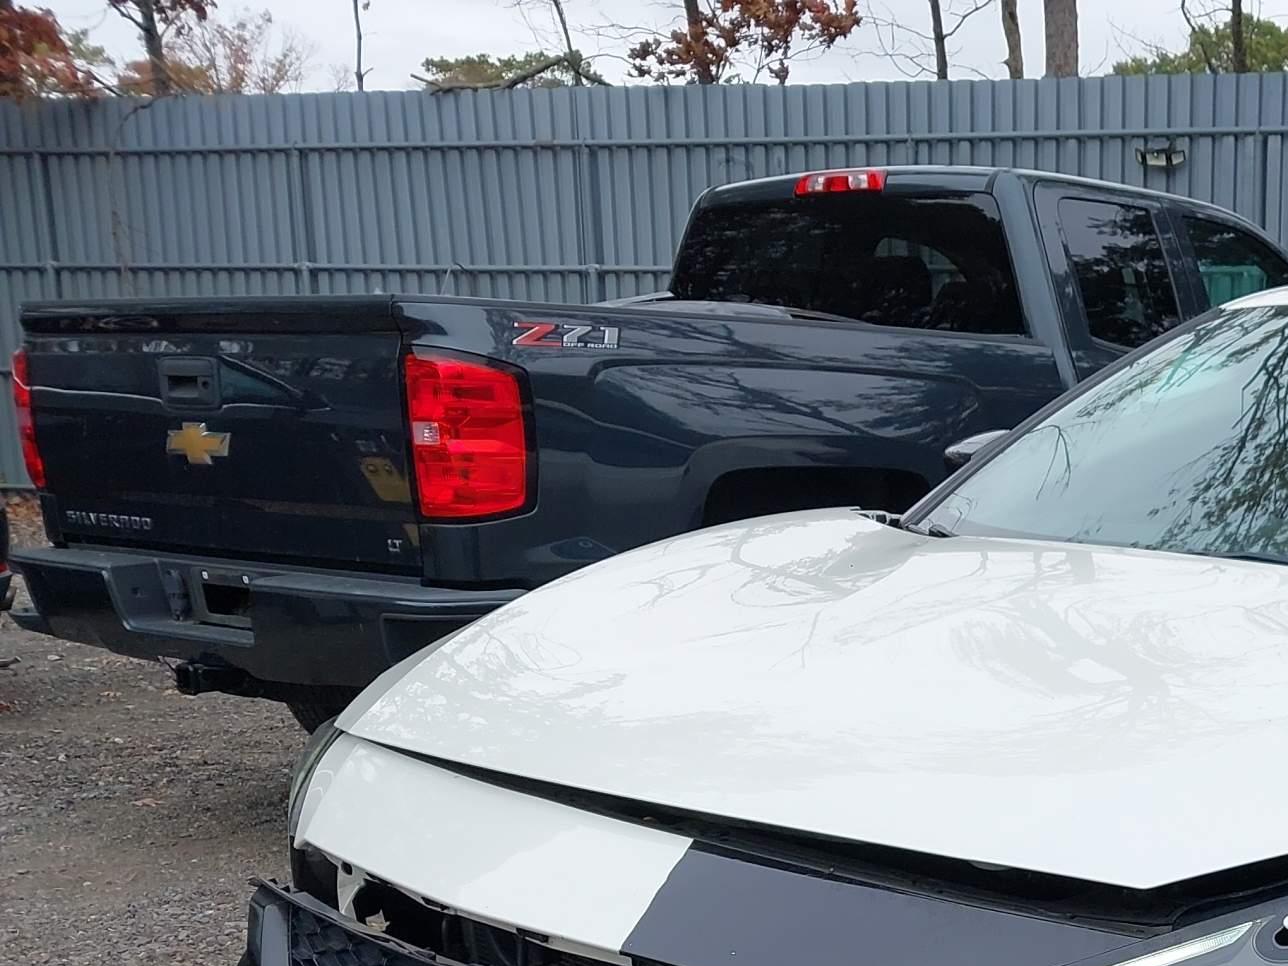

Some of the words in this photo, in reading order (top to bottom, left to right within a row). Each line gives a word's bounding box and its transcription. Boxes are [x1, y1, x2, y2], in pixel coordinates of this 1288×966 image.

[512, 322, 619, 346] Z71
[66, 510, 152, 530] SILVERADO
[387, 538, 403, 552] LT
